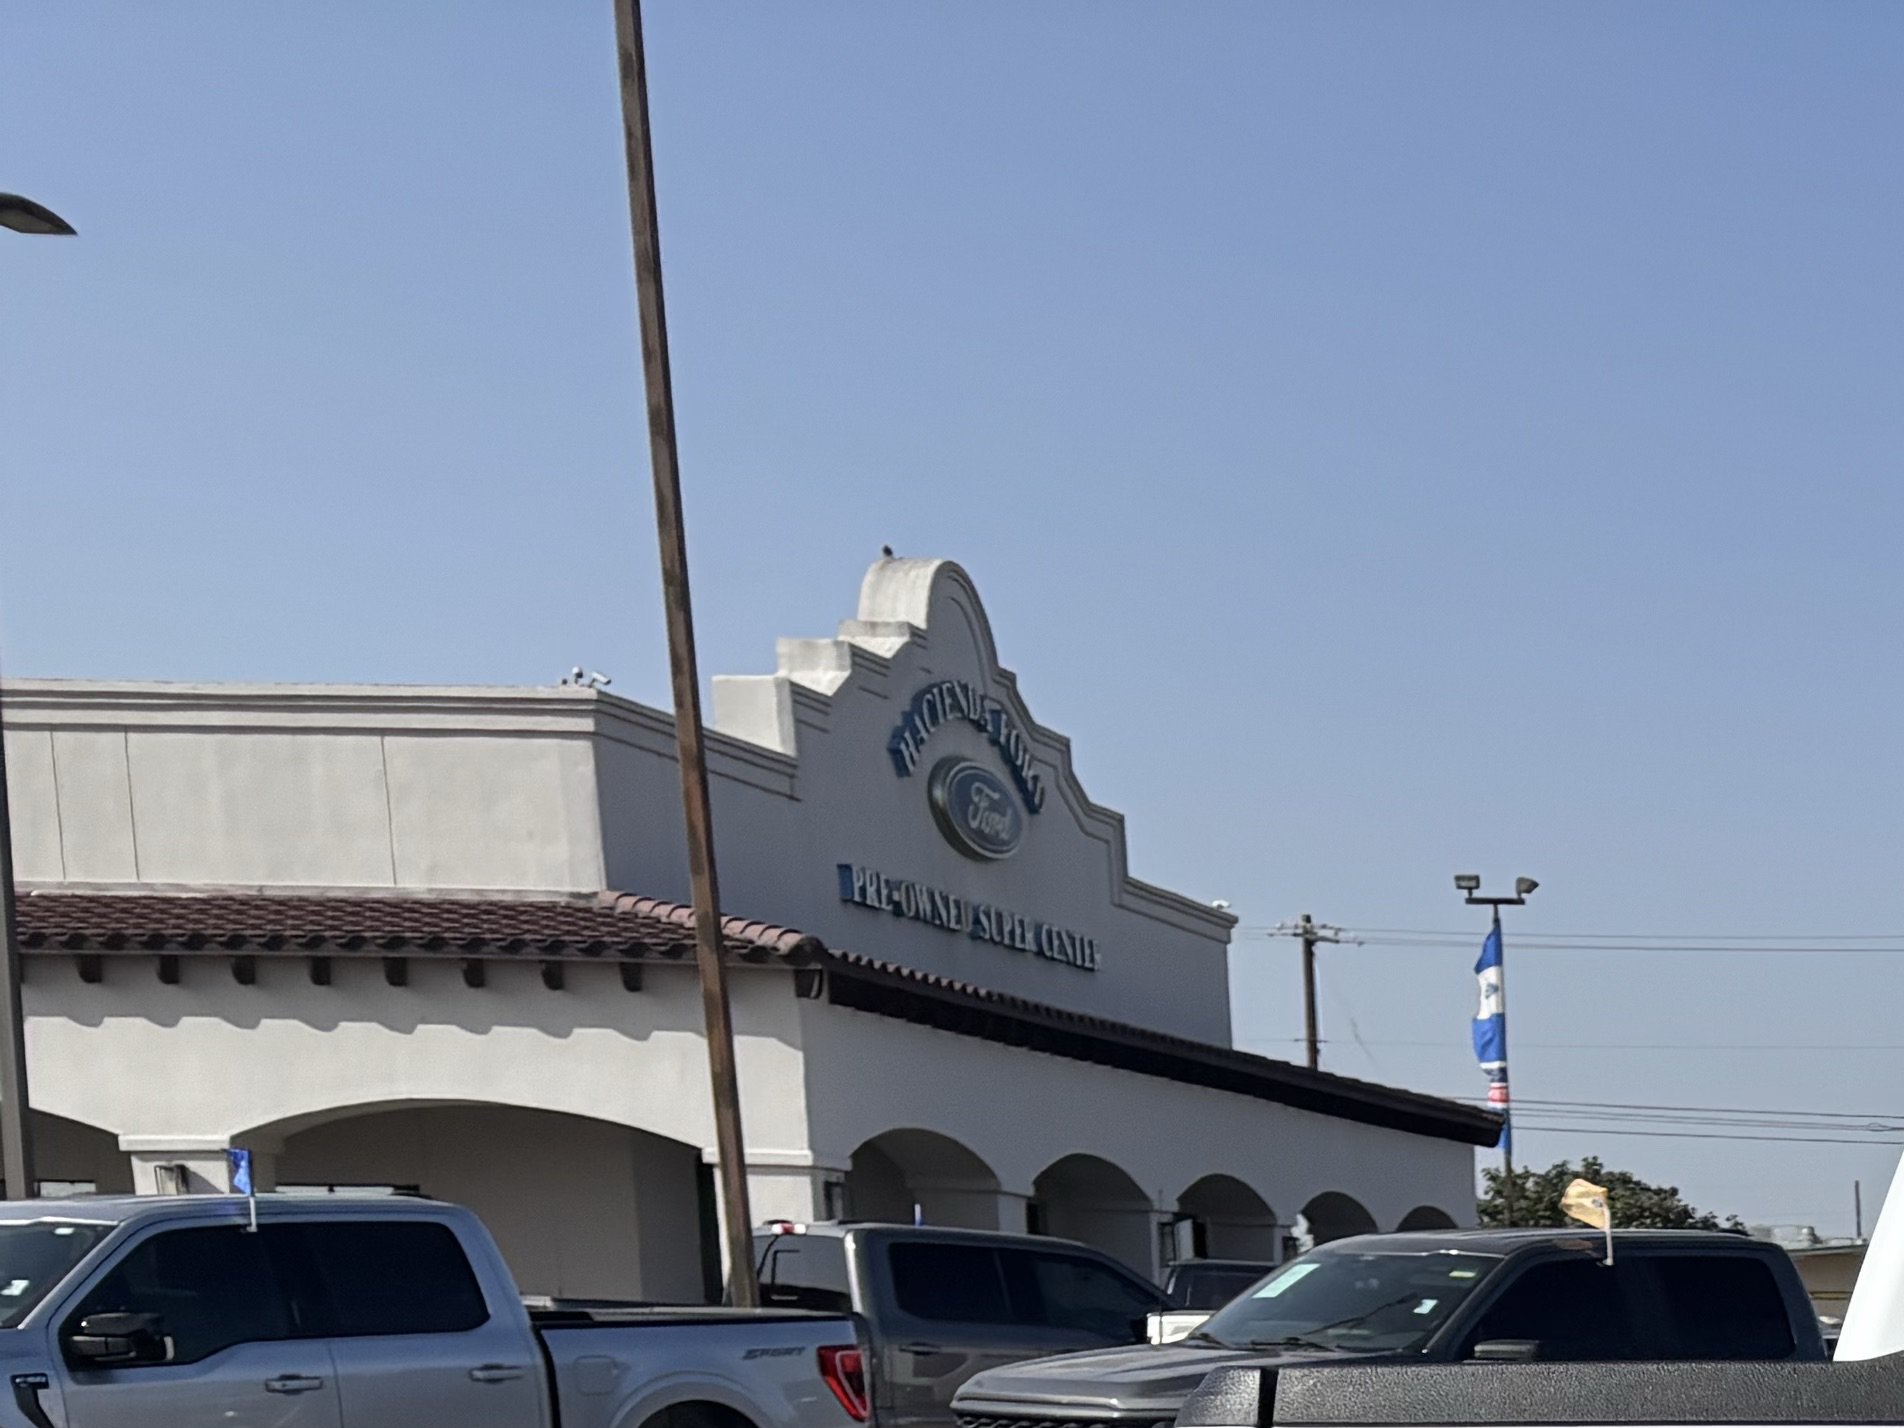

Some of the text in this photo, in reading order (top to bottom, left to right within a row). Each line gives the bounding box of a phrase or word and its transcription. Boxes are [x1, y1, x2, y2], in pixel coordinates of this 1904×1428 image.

[899, 680, 994, 774] HACIENDA
[968, 781, 1013, 840] Ford
[852, 866, 1101, 971] PRE-OWNED SUPER CENTER
